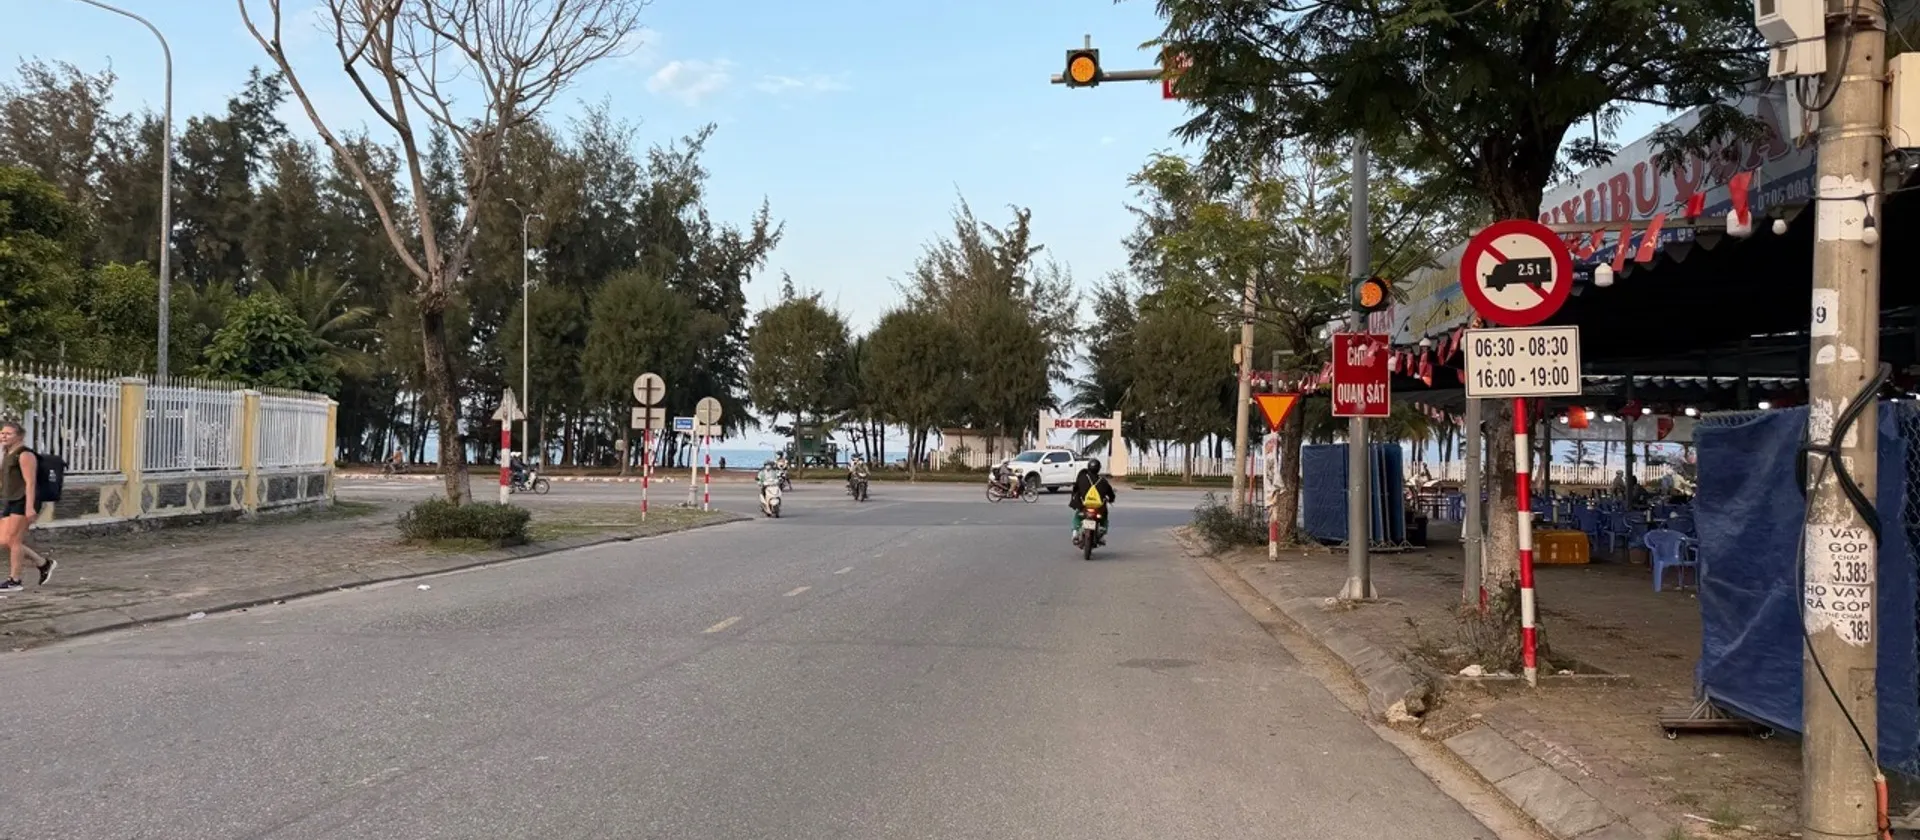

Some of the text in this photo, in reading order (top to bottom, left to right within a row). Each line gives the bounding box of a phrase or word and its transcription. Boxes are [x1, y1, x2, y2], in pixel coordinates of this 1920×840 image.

[1518, 263, 1541, 276] 2.5 t
[1475, 337, 1515, 357] 06:30
[1528, 336, 1568, 356] 08:30
[1476, 368, 1516, 388] 16:00
[1530, 366, 1569, 387] 19:00
[1337, 380, 1386, 405] QUAN SÁT
[1054, 420, 1107, 428] RED BEACH
[1829, 528, 1863, 539] VAY
[1828, 541, 1868, 553] GÓP
[1833, 561, 1868, 582] 3.383
[1832, 587, 1867, 598] VAY
[1831, 600, 1871, 612] GÓP
